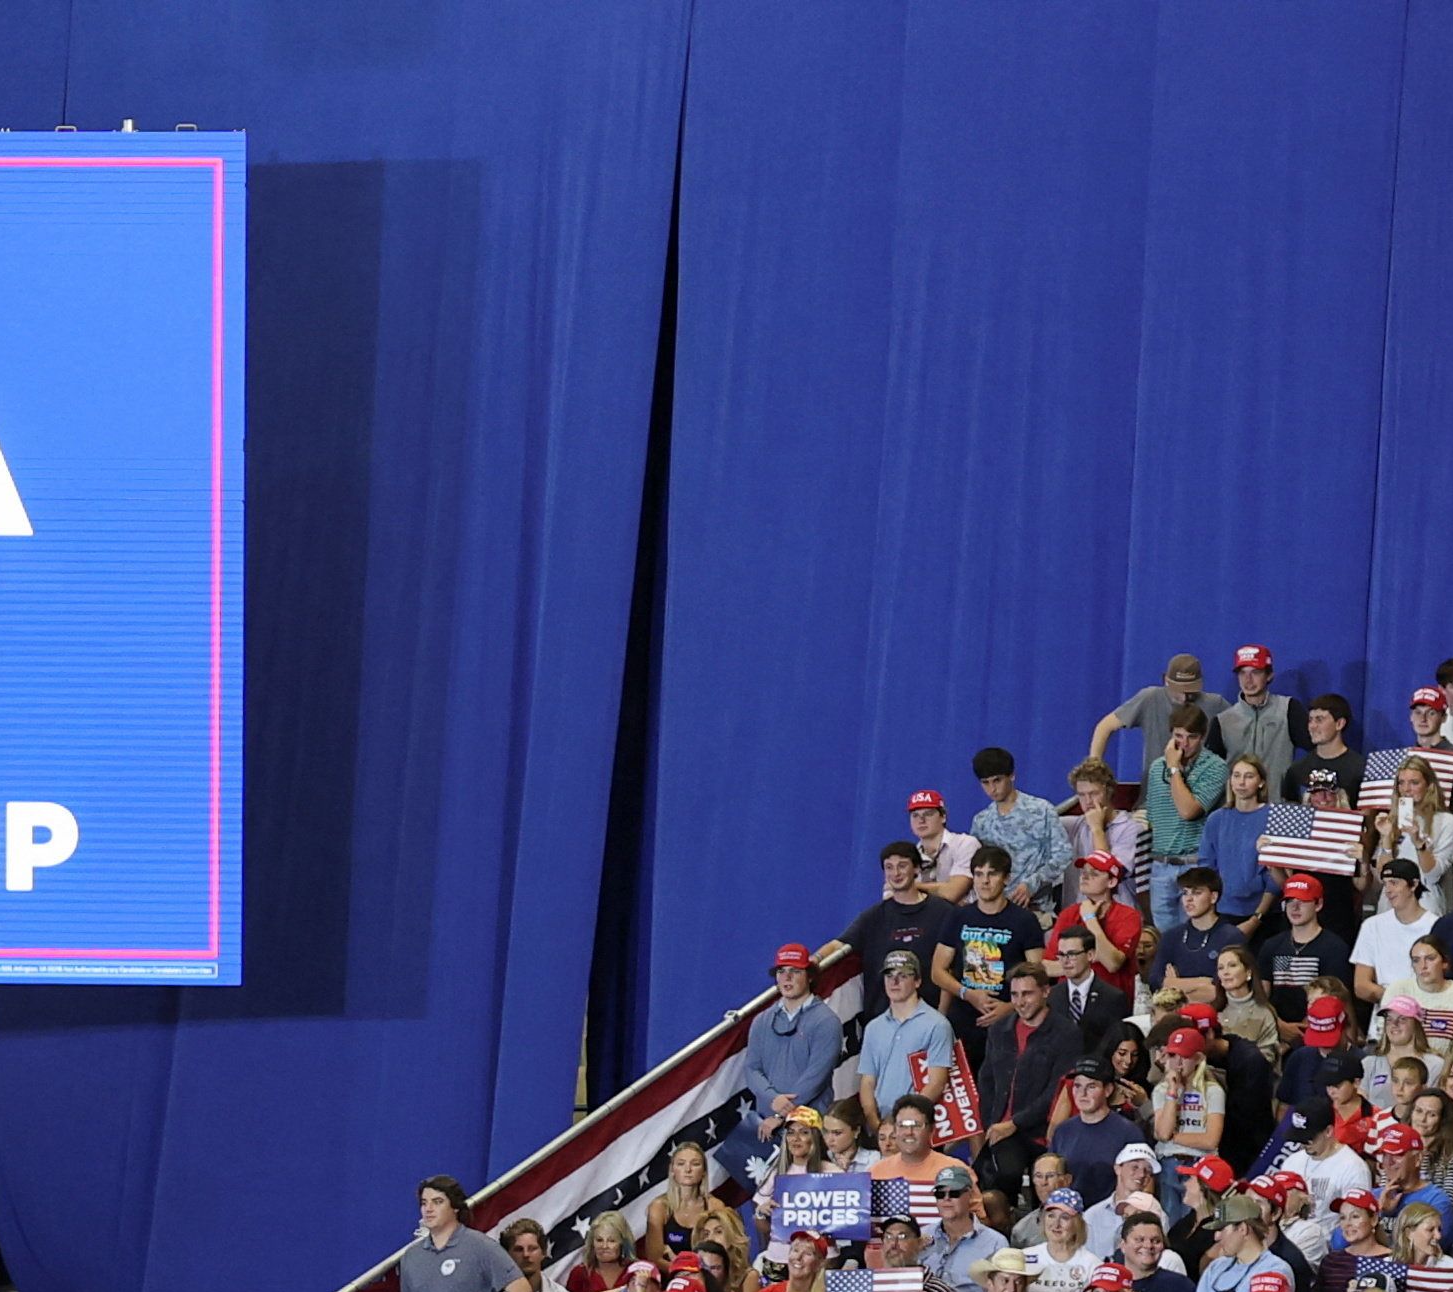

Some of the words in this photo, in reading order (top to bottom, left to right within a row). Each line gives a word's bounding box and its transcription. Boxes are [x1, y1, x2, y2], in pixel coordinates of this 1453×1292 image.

[961, 931, 992, 943] GULF
[993, 934, 1012, 945] OF
[932, 1103, 954, 1140] NO
[783, 1191, 861, 1208] LOWER
[783, 1209, 860, 1227] PRICES
